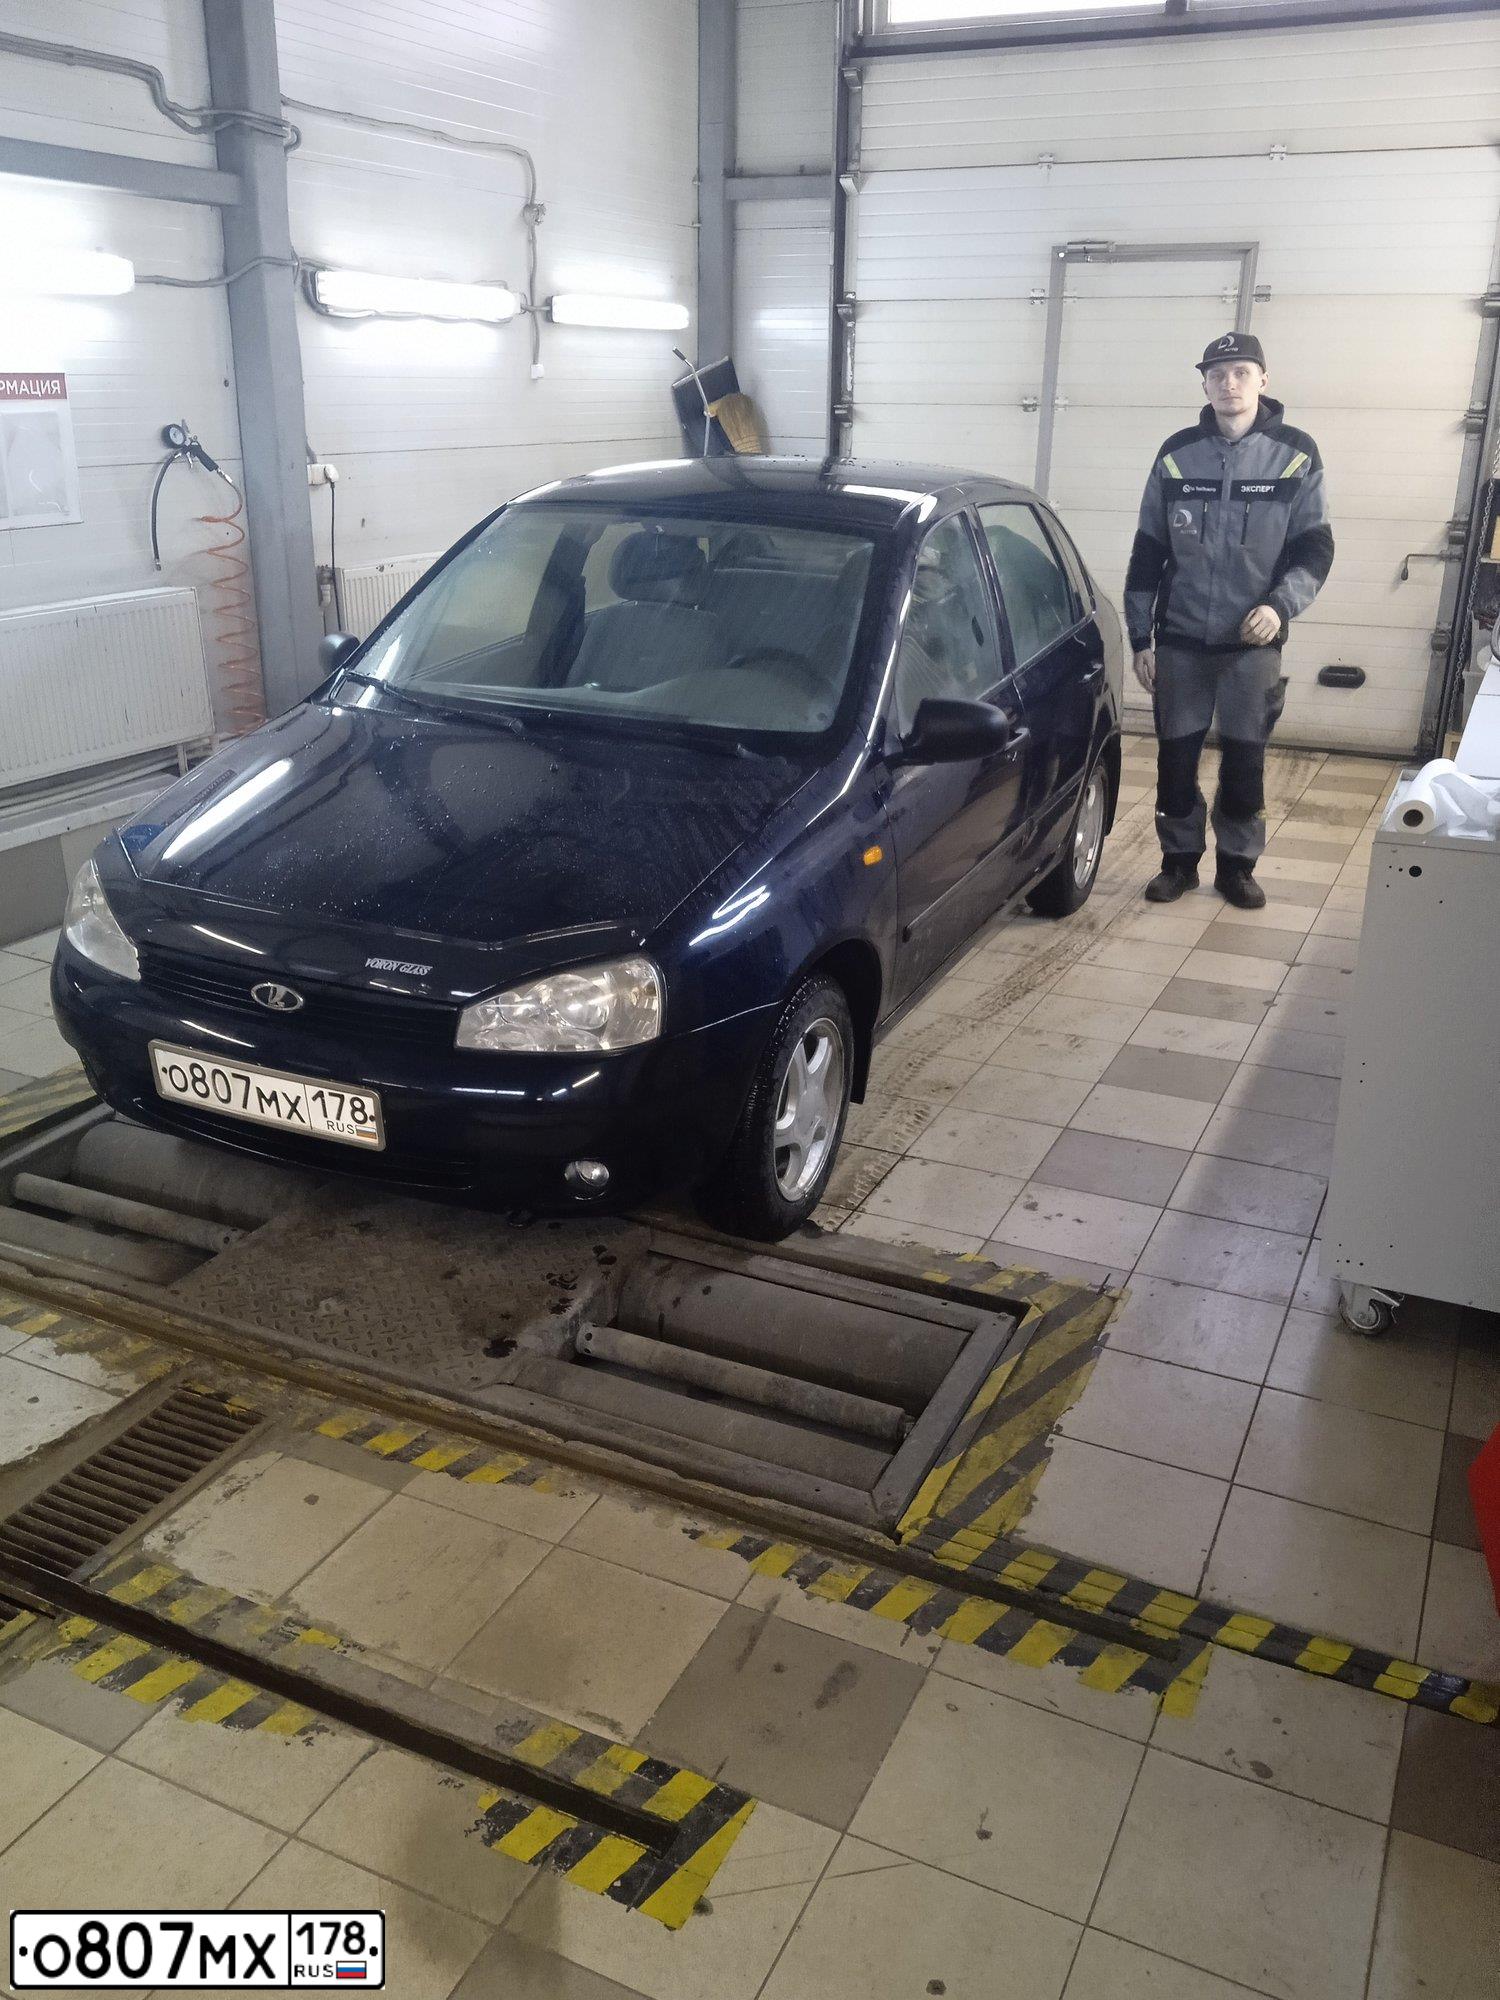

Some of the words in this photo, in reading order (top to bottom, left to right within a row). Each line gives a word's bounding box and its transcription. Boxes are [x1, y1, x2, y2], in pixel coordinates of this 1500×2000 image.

[1240, 485, 1276, 493] ЭКСПЕРТ
[365, 957, 400, 971] VORON
[399, 961, 433, 975] GLASS
[312, 1090, 368, 1124] 178
[326, 1120, 355, 1134] RUS
